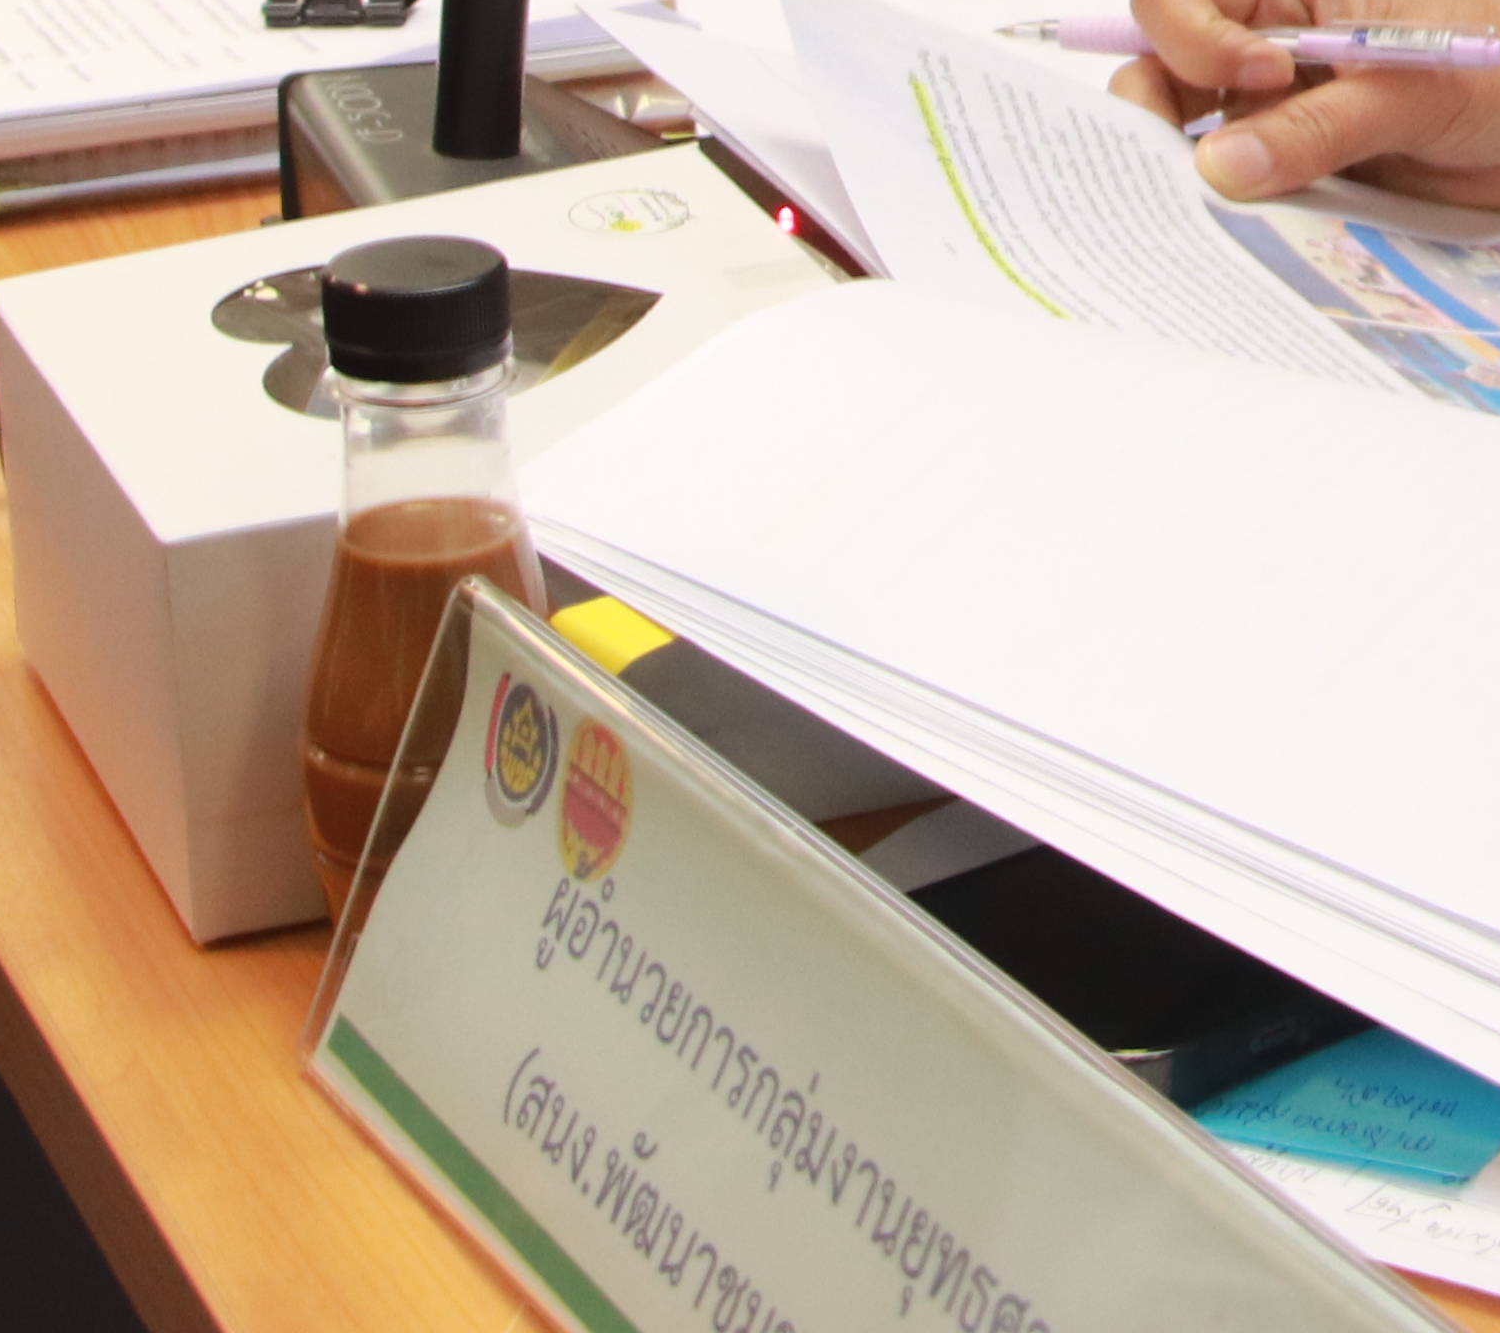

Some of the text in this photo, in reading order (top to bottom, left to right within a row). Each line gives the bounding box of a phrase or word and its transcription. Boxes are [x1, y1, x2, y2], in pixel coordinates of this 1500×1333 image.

[534, 849, 1052, 1333] ผู้อำนวยการกลุ่มงานยุทธศ
